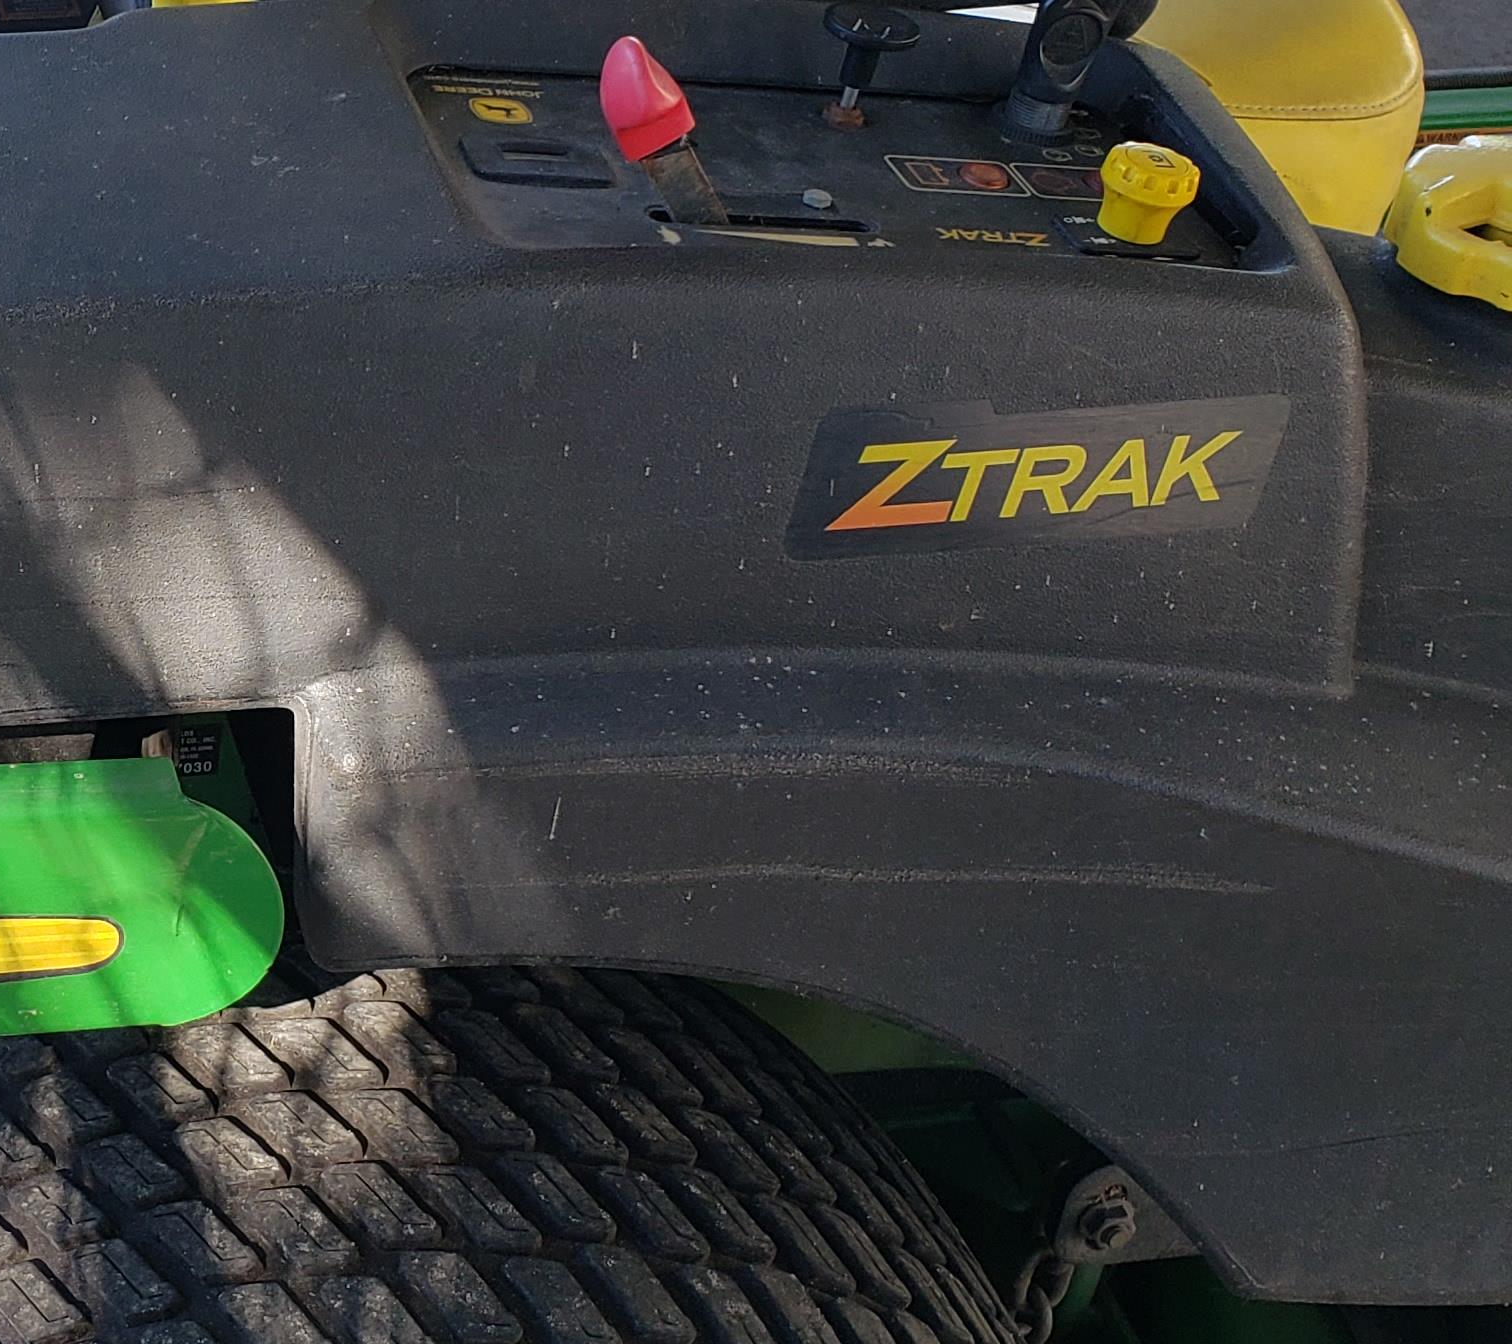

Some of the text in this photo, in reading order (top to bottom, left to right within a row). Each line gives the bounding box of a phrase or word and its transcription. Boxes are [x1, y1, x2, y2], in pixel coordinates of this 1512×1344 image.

[431, 84, 545, 99] JOHN DEERE
[935, 227, 1051, 247] ZTRAK
[824, 430, 1244, 532] ZTRAK
